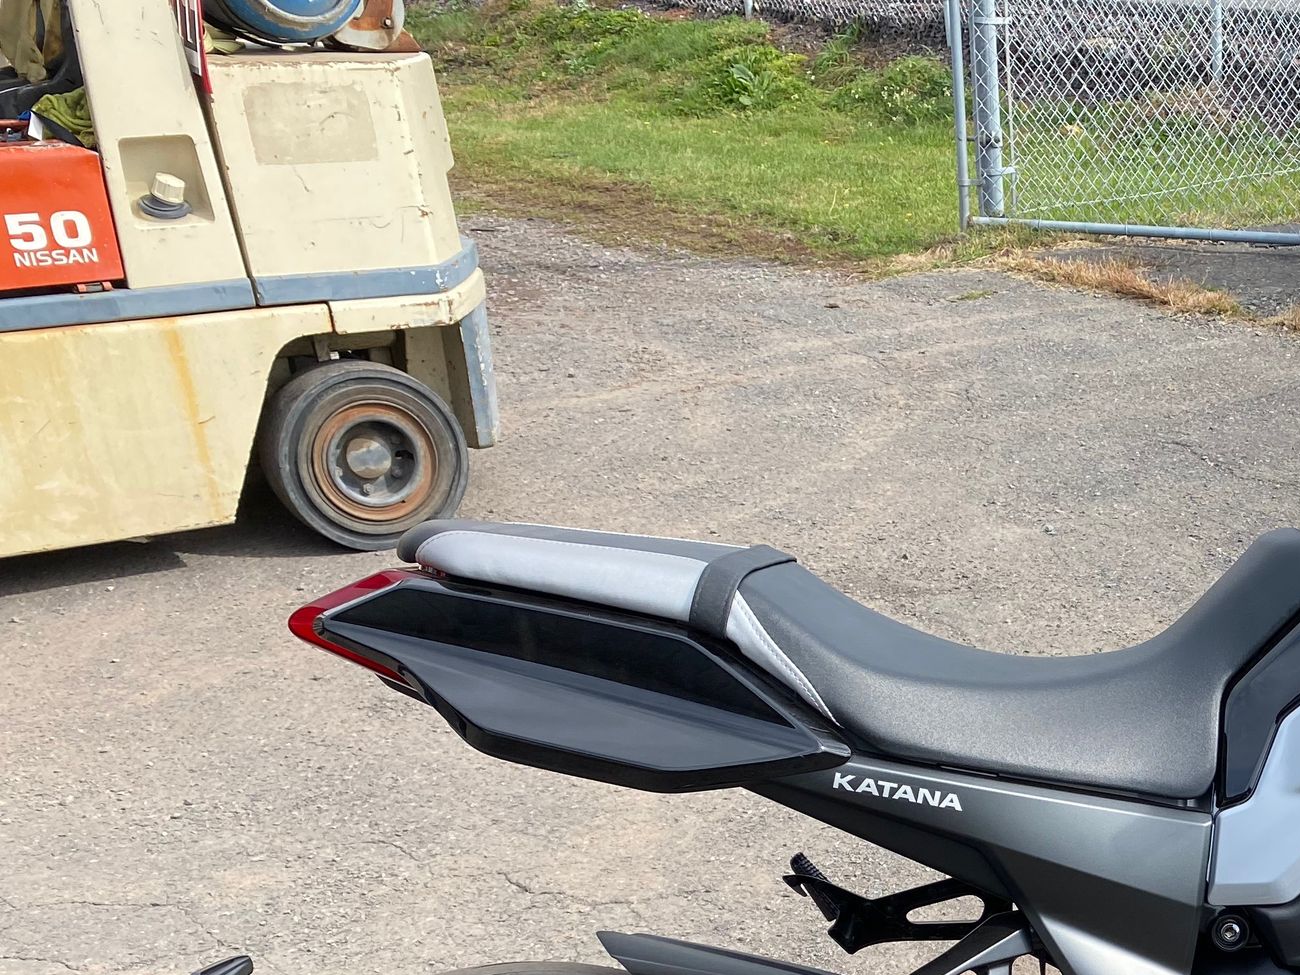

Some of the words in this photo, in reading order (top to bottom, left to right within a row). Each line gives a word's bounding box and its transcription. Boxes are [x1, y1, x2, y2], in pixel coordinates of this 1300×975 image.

[4, 210, 92, 251] 50
[13, 247, 99, 268] NISSAN
[833, 772, 963, 812] KATANA
